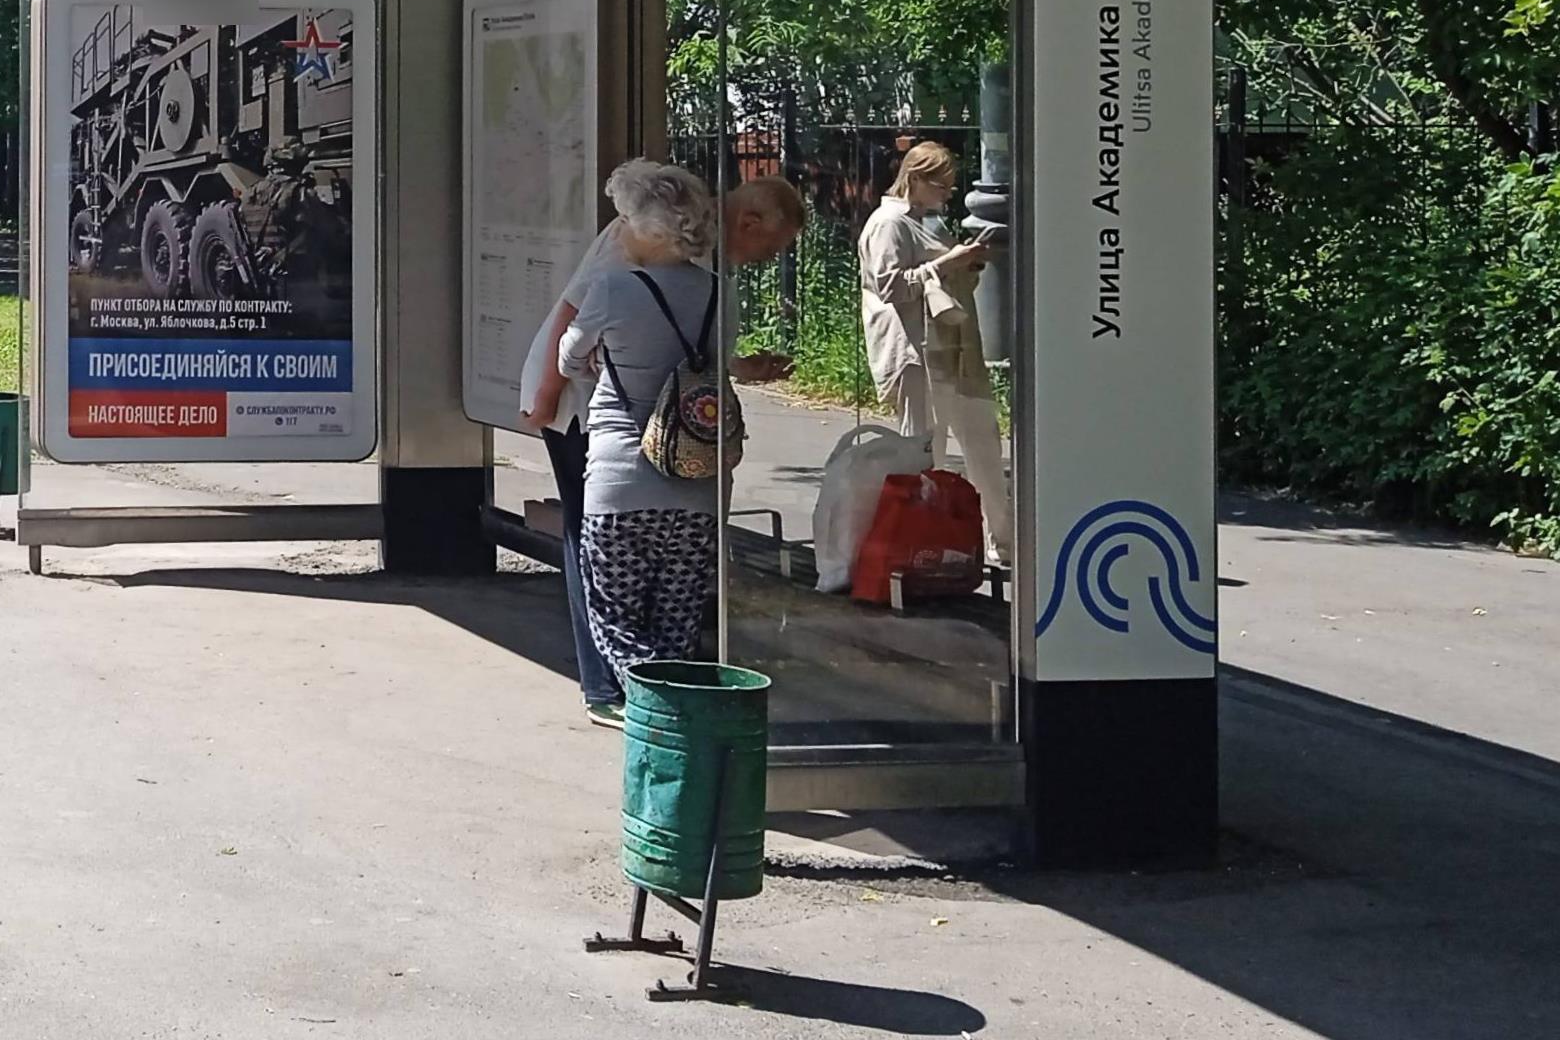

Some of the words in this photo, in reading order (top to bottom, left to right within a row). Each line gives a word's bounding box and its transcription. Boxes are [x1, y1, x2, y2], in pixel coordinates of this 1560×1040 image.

[1092, 6, 1124, 216] Академика
[1132, 68, 1151, 132] Ulitsa
[1092, 228, 1124, 339] Улица
[90, 299, 123, 311] ПУНКТ
[124, 299, 161, 311] ОТБОРА
[163, 300, 176, 311] НА
[178, 299, 217, 312] СЛУЖБУ
[219, 300, 232, 312] ПО
[235, 300, 293, 313] КОНТРАКТУ:
[91, 318, 99, 328] г.
[100, 315, 142, 329] Москва,
[144, 317, 159, 330] ул.
[160, 315, 218, 330] Яблочкова,
[238, 318, 259, 331] стр.
[261, 316, 266, 329] 1
[89, 349, 252, 380] ПРИСОЕДИНЯЙСЯ
[256, 355, 269, 378] К
[273, 355, 337, 379] СВОИМ
[88, 405, 175, 425] НАСТОЯЩЕЕ
[178, 406, 217, 426] ДЕЛО
